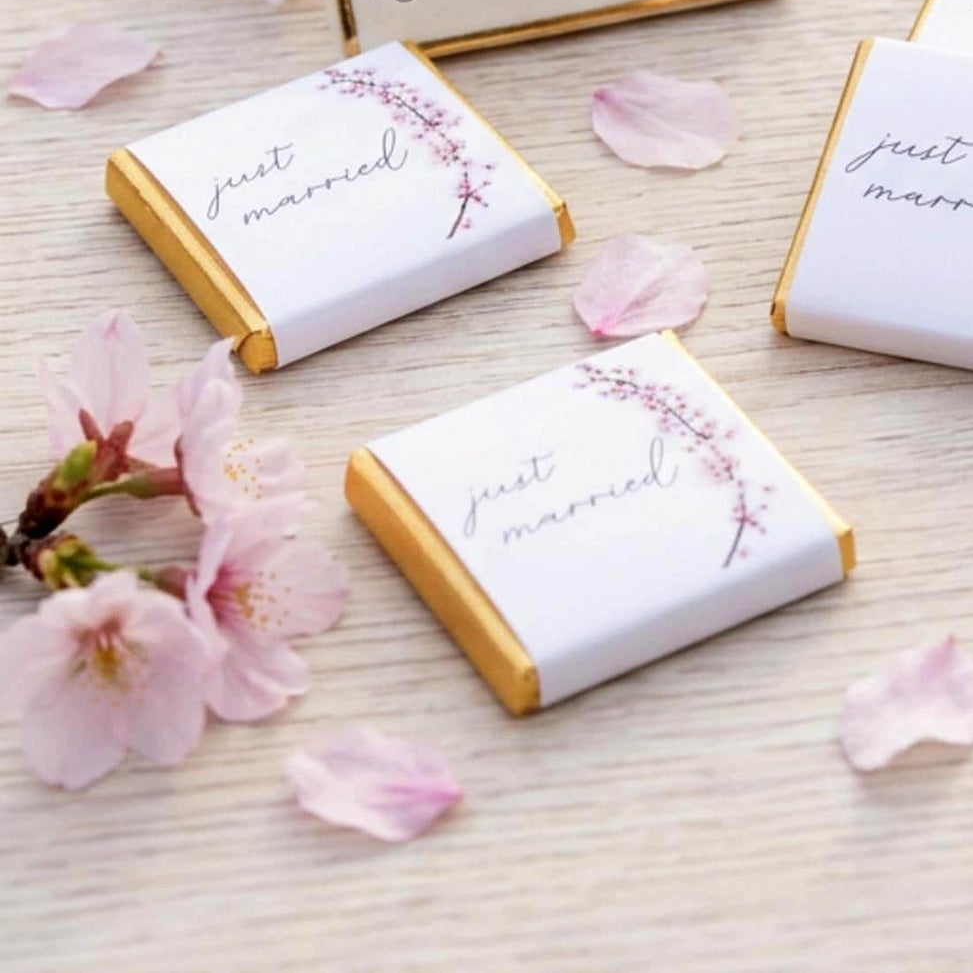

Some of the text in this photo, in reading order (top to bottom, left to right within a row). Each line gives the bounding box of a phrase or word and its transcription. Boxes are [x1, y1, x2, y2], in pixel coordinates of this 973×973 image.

[206, 142, 295, 221] just
[242, 127, 409, 226] married
[462, 450, 555, 538] just
[502, 436, 679, 546] married
